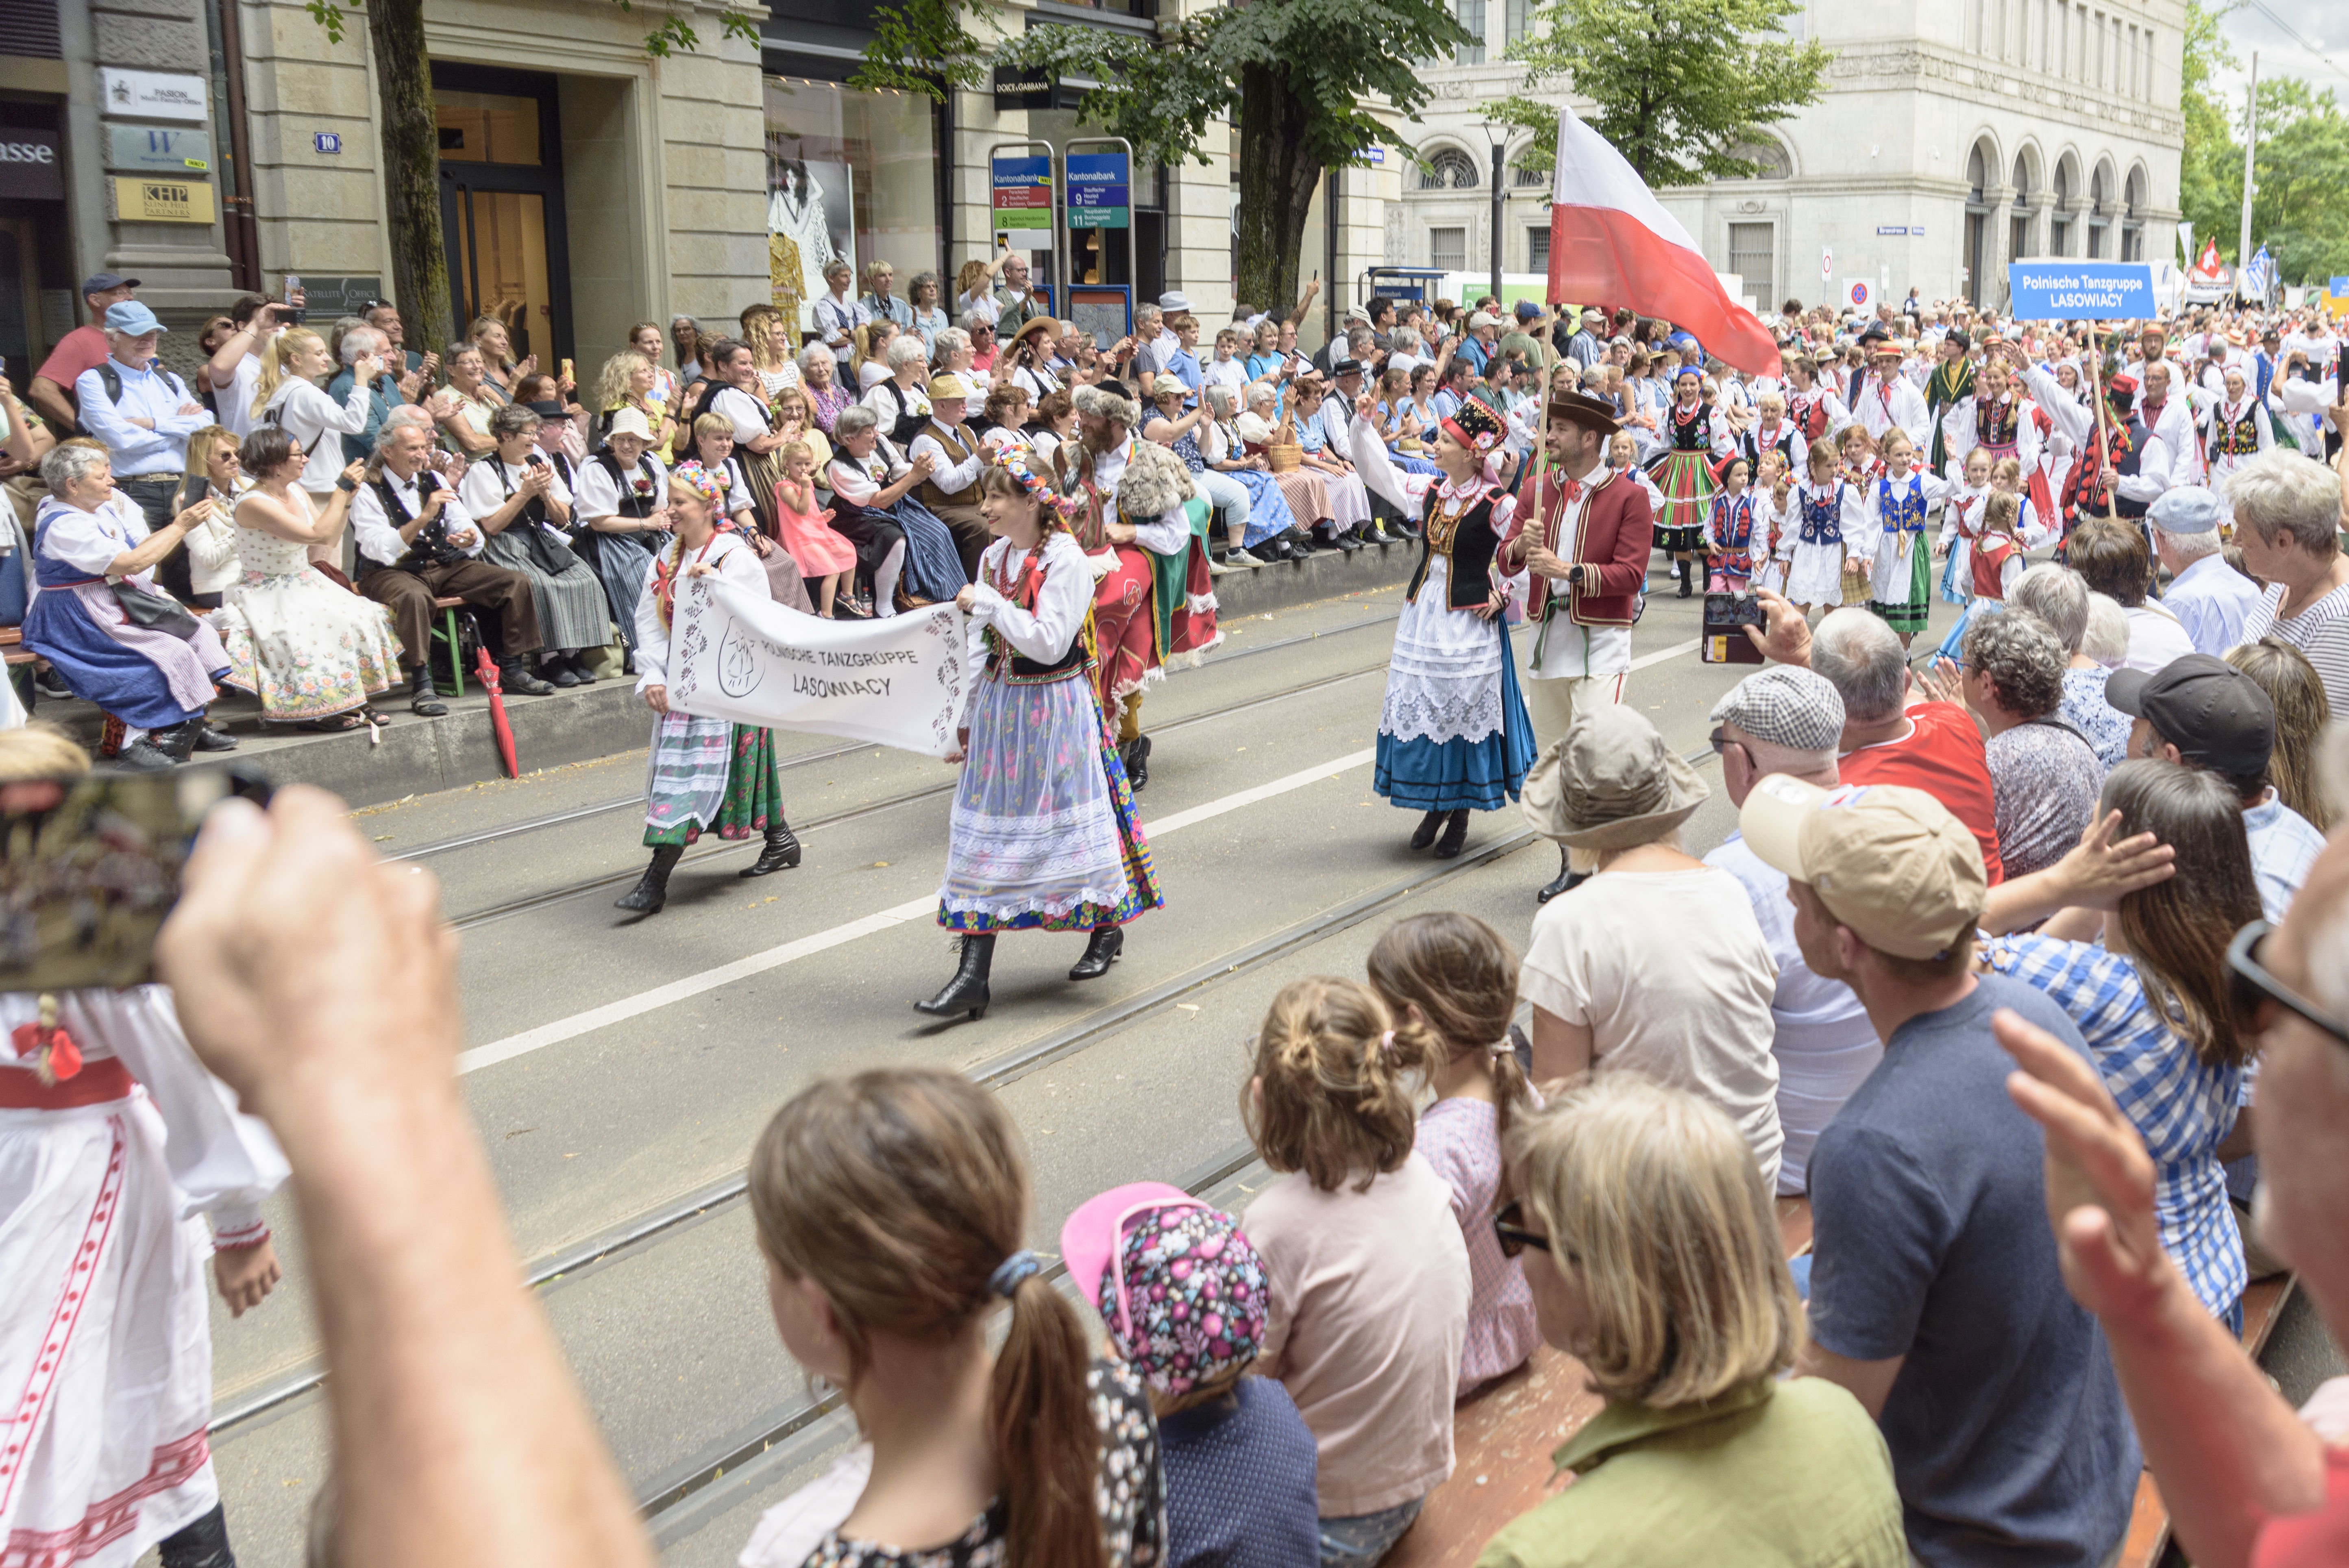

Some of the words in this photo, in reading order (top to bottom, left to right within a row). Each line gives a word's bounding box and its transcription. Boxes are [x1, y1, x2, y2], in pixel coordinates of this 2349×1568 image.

[155, 88, 187, 98] PASION
[147, 130, 181, 153] W
[321, 135, 335, 150] 10
[994, 174, 1038, 183] Kantonalbank
[1069, 171, 1115, 181] Kantonalbank
[1001, 196, 1008, 207] 2
[1075, 193, 1082, 205] 9
[1002, 217, 1008, 227] 8
[1073, 215, 1083, 226] 11
[2022, 275, 2079, 290] Polnische
[2081, 275, 2142, 292] Tanzgruppe
[2051, 293, 2123, 307] LASOWIACY
[761, 639, 816, 664] POLNISCHE
[793, 673, 890, 698] LASOWIACY
